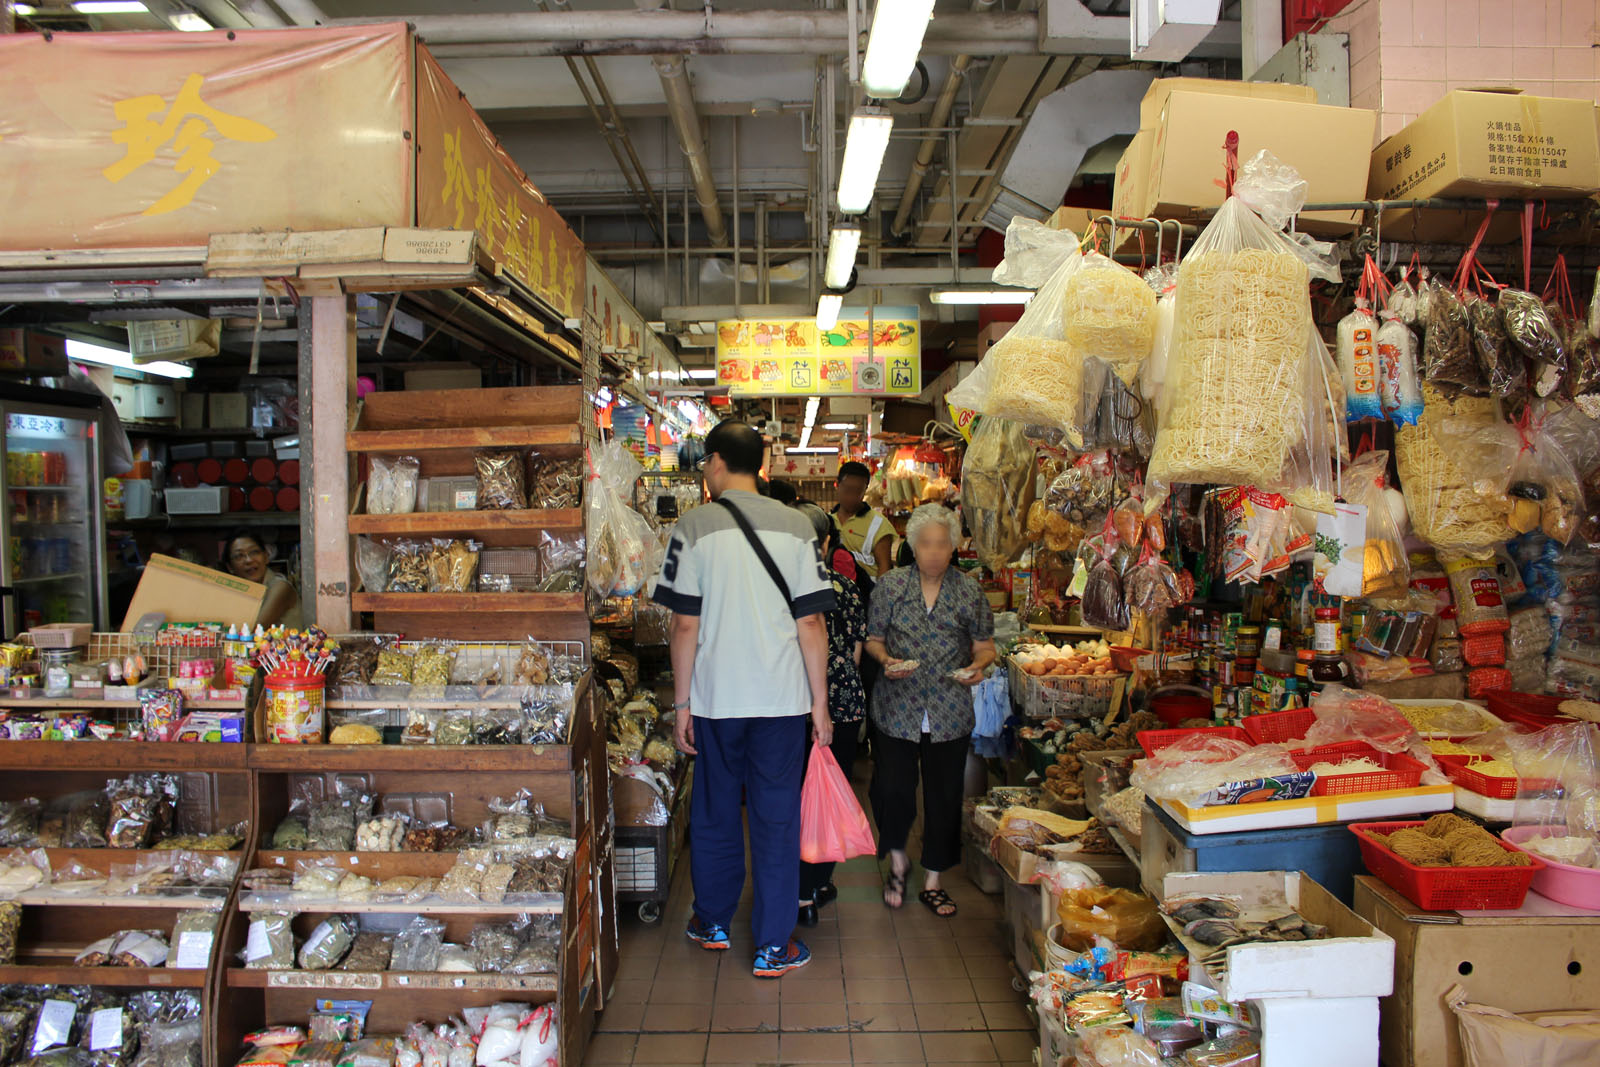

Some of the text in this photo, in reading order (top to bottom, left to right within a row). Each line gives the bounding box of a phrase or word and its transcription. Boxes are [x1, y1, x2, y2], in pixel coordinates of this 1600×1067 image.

[1487, 120, 1522, 131] 火鍋佳品
[102, 72, 278, 216] 珍
[1489, 165, 1542, 178] 此日期前食用
[663, 536, 684, 583] 5
